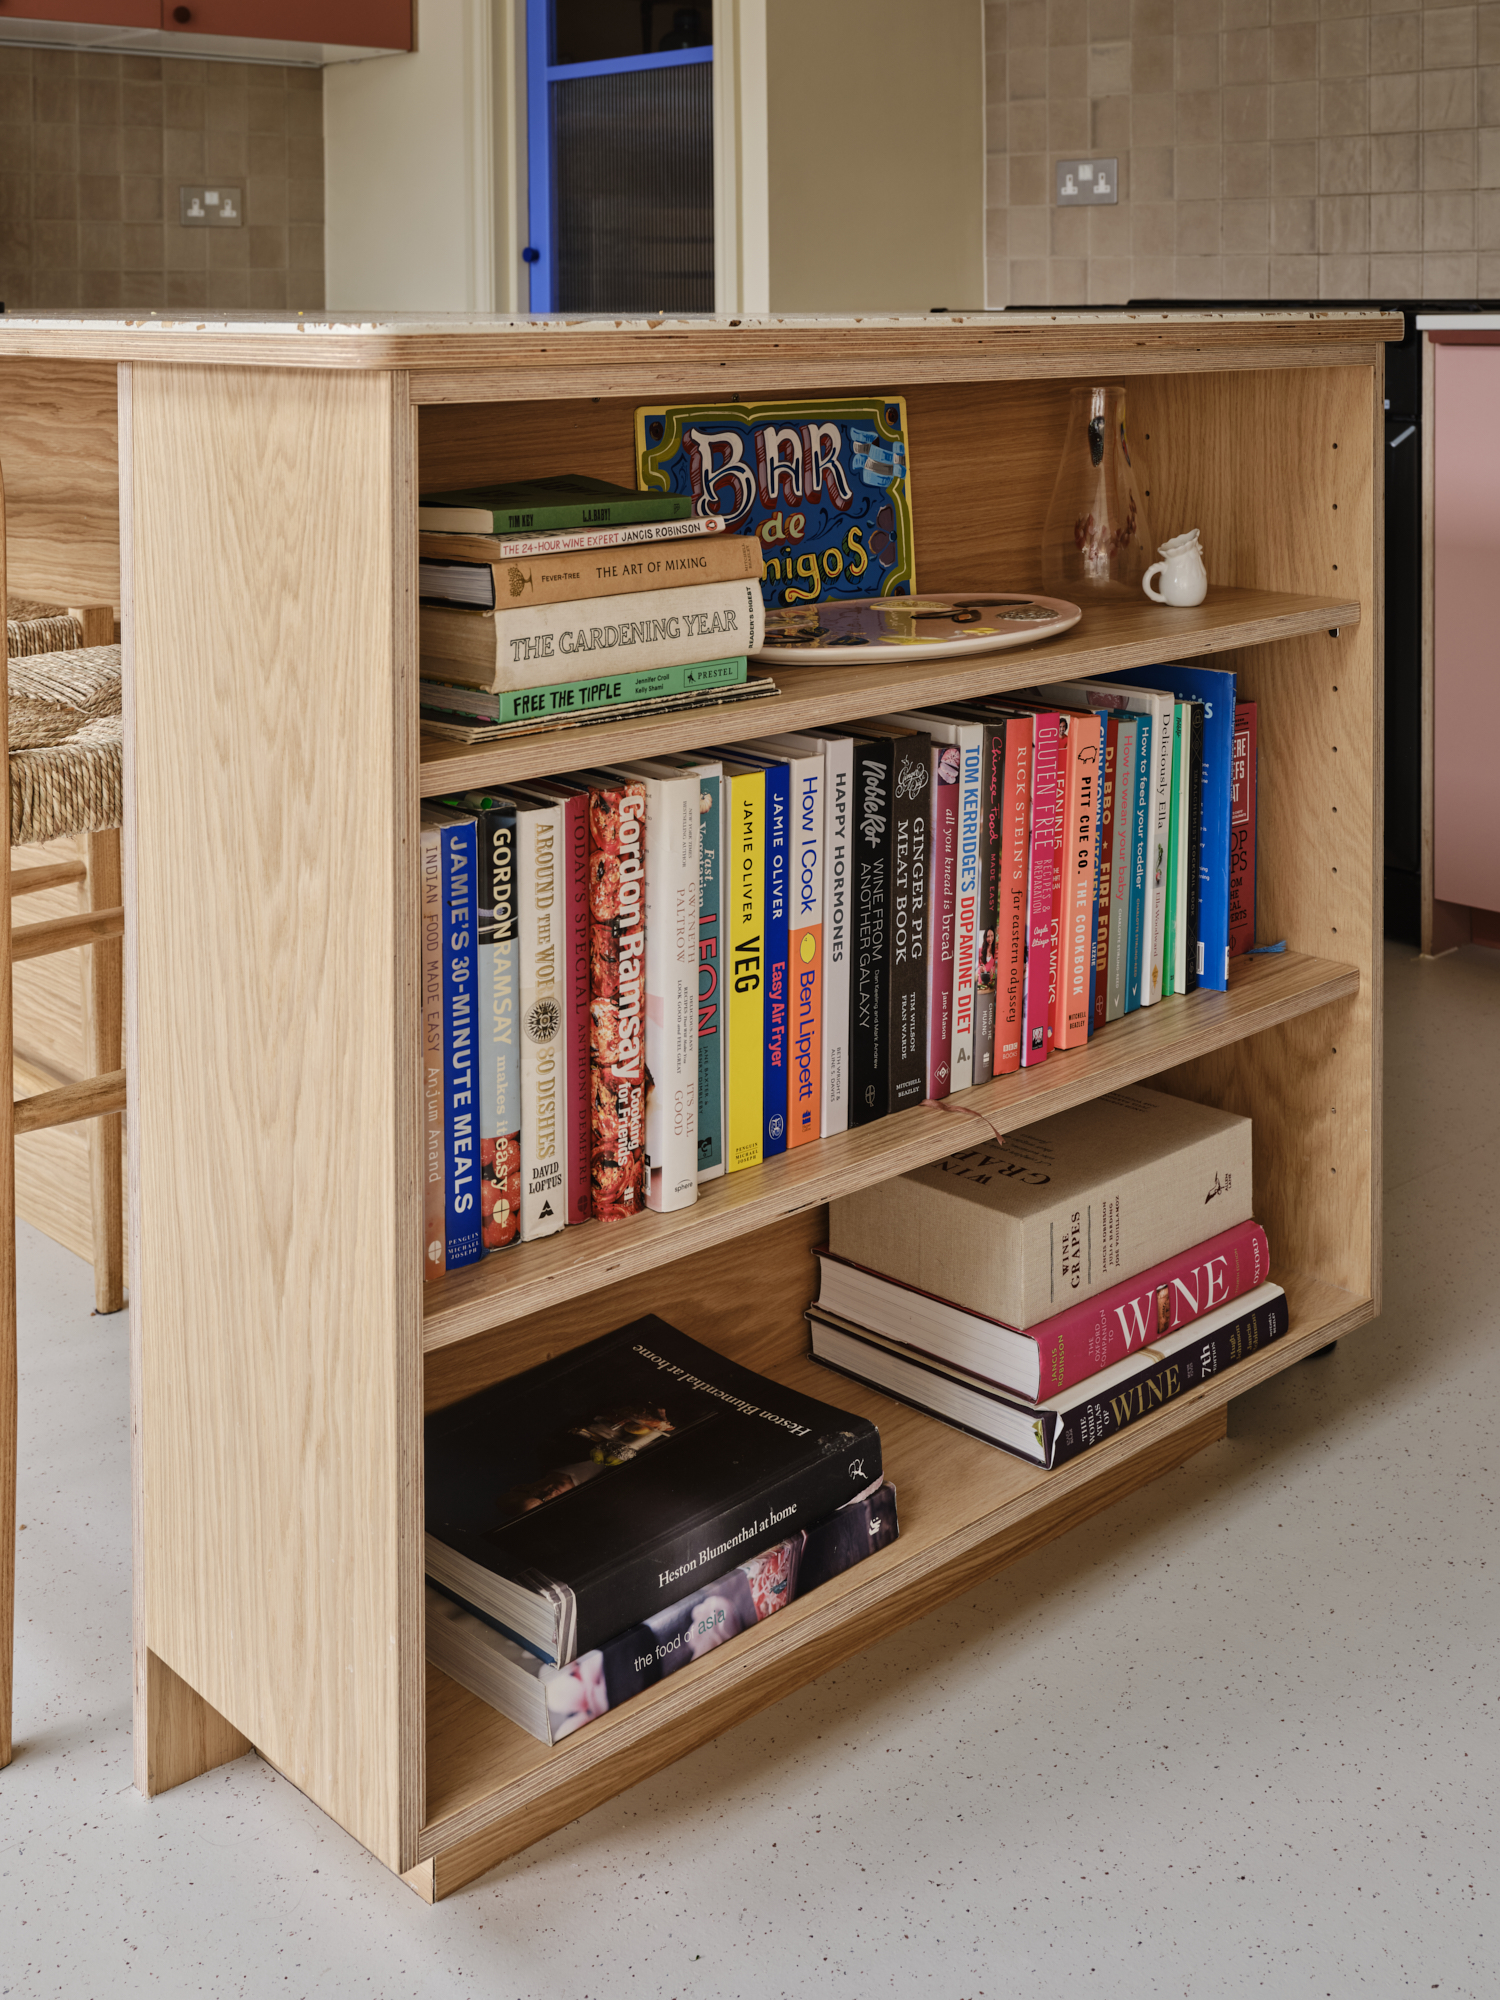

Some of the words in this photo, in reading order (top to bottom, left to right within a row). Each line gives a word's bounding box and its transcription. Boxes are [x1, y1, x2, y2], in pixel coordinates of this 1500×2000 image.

[688, 421, 853, 526] BAR
[508, 515, 521, 528] TIM
[521, 514, 534, 527] KEY
[621, 527, 653, 542] JANCIS
[655, 522, 701, 538] ROBINSON
[761, 510, 806, 543] de
[503, 545, 520, 556] THE
[521, 540, 561, 554] 24-HOUR
[562, 537, 585, 550] WINE
[587, 533, 619, 546] EXPERT
[596, 565, 618, 579] THE
[622, 562, 643, 576] ART
[647, 560, 661, 573] OF
[665, 556, 708, 571] MIXING
[762, 526, 868, 603] migos
[510, 634, 554, 662] THE
[558, 618, 681, 655] GARDENING
[683, 609, 739, 637] YEAR
[635, 686, 649, 695] Kelly
[649, 684, 664, 692] Shami
[698, 667, 733, 680] PRESTEL
[513, 694, 546, 716] FREE
[550, 689, 575, 709] THE
[579, 682, 622, 705] TIPPLE
[964, 745, 980, 784] TOM
[1036, 727, 1058, 795] GLUTEN
[1105, 746, 1114, 774] DJ
[1122, 735, 1133, 767] How
[1141, 727, 1149, 757] How
[1157, 713, 1171, 796] Deliciously
[988, 736, 1003, 804] Chinese
[1016, 746, 1027, 796] RICK
[1122, 771, 1130, 787] to
[1140, 759, 1148, 774] to
[801, 776, 818, 832] How
[834, 772, 847, 839] HAPPY
[1080, 776, 1092, 808] PITT
[1120, 789, 1129, 827] wean
[1138, 777, 1148, 807] feed
[1157, 801, 1166, 829] Ella
[743, 800, 753, 853] JAMIE
[773, 793, 784, 848] JAMIE
[945, 808, 955, 825] all
[1034, 805, 1055, 851] FREE
[1079, 815, 1090, 843] CUE
[1136, 809, 1145, 839] your
[573, 809, 586, 904] TODAY'S
[618, 795, 645, 929] Gordon
[896, 819, 909, 889] MEAT
[943, 828, 953, 853] you
[961, 788, 979, 893] KERRIDGE'S
[1012, 802, 1025, 880] STEIN'S
[1077, 850, 1089, 875] CO.
[1117, 830, 1127, 862] your
[425, 847, 438, 905] INDIAN
[492, 828, 512, 940] GORDON
[534, 822, 555, 913] AROUND
[704, 848, 715, 882] Fast
[772, 855, 783, 921] OLIVER
[800, 849, 817, 916] Cook
[873, 857, 884, 903] WINE
[912, 817, 925, 914] GINGER
[944, 857, 954, 896] knead
[989, 853, 997, 882] MADE
[1033, 860, 1043, 914] PREPARATION
[1042, 858, 1052, 900] RECIPES
[1098, 862, 1111, 909] FIRE
[1115, 865, 1127, 901] baby
[1135, 841, 1144, 890] toddler
[450, 835, 470, 951] JAMIE'S
[742, 858, 753, 924] OLIVER
[832, 846, 845, 963] HORMONES
[859, 862, 873, 950] ANOTHER
[943, 899, 952, 910] is
[1010, 888, 1023, 911] far
[1042, 905, 1050, 913] &
[1076, 880, 1088, 908] THE
[426, 914, 439, 953] FOOD
[536, 913, 551, 946] THE
[675, 888, 686, 964] PALTROW
[687, 881, 696, 964] GWYNETH
[872, 908, 884, 962] FROM
[895, 896, 908, 966] BOOK
[911, 917, 923, 960] PIG
[941, 912, 954, 962] bread
[958, 895, 975, 992] DOPAMINE
[1010, 915, 1020, 965] eastern
[1096, 914, 1109, 973] FOOD
[574, 913, 587, 1015] SPECIAL
[734, 935, 760, 994] VEG
[1072, 914, 1086, 996] COOKBOOK
[427, 960, 440, 1006] MADE
[492, 939, 513, 1046] RAMSAY
[768, 961, 786, 1000] Easy
[799, 969, 816, 1017] Ben
[859, 953, 871, 1029] GALAXY
[941, 991, 949, 1010] Jane
[1006, 968, 1020, 1023] odyssey
[611, 932, 646, 1080] Ramsay
[771, 1003, 785, 1025] Air
[941, 1012, 949, 1041] Mason
[957, 993, 972, 1034] DIET
[427, 1011, 440, 1053] EASY
[451, 955, 472, 1109] 30-MINUTE
[768, 1025, 785, 1068] Fryer
[536, 1045, 556, 1076] 80
[577, 1023, 588, 1106] ANTHONY
[795, 1018, 815, 1102] Lippett
[426, 1067, 441, 1123] Anjum
[496, 1054, 509, 1116] makes
[618, 1081, 632, 1105] for
[686, 1082, 695, 1107] IT'S
[896, 1077, 922, 1091] MITCHELL
[898, 1085, 920, 1098] BEAZLEY
[496, 1119, 508, 1137] it
[536, 1078, 556, 1161] DISHES
[626, 1087, 642, 1151] Cooking
[674, 1090, 684, 1136] GOOD
[686, 1112, 694, 1138] ALL
[428, 1129, 442, 1184] Anand
[578, 1109, 588, 1185] DEMETRE
[617, 1106, 631, 1168] Friends
[453, 1112, 474, 1214] MEALS
[491, 1137, 509, 1193] easy
[528, 1173, 563, 1195] LOFTUS
[532, 1161, 560, 1180] DAVID
[674, 1181, 693, 1193] sphere
[1070, 1211, 1081, 1289] GRAPES
[1252, 1237, 1261, 1284] OXFORD
[632, 1344, 668, 1371] home
[667, 1365, 685, 1378] at
[1200, 1343, 1212, 1378] 7th
[677, 1372, 761, 1416] Blumenthal
[1109, 1363, 1181, 1428] WINE
[759, 1410, 812, 1437] Heston
[1080, 1416, 1088, 1442] THE
[1086, 1404, 1095, 1446] WORLD
[1094, 1403, 1103, 1437] ATLAS
[1102, 1409, 1110, 1426] OF
[658, 1559, 697, 1588] Heston
[698, 1520, 758, 1566] Blumenthal
[759, 1517, 769, 1532] at
[769, 1503, 797, 1526] home
[634, 1652, 653, 1672] the
[655, 1633, 681, 1660] food
[684, 1626, 696, 1643] of
[697, 1609, 726, 1635] asia
